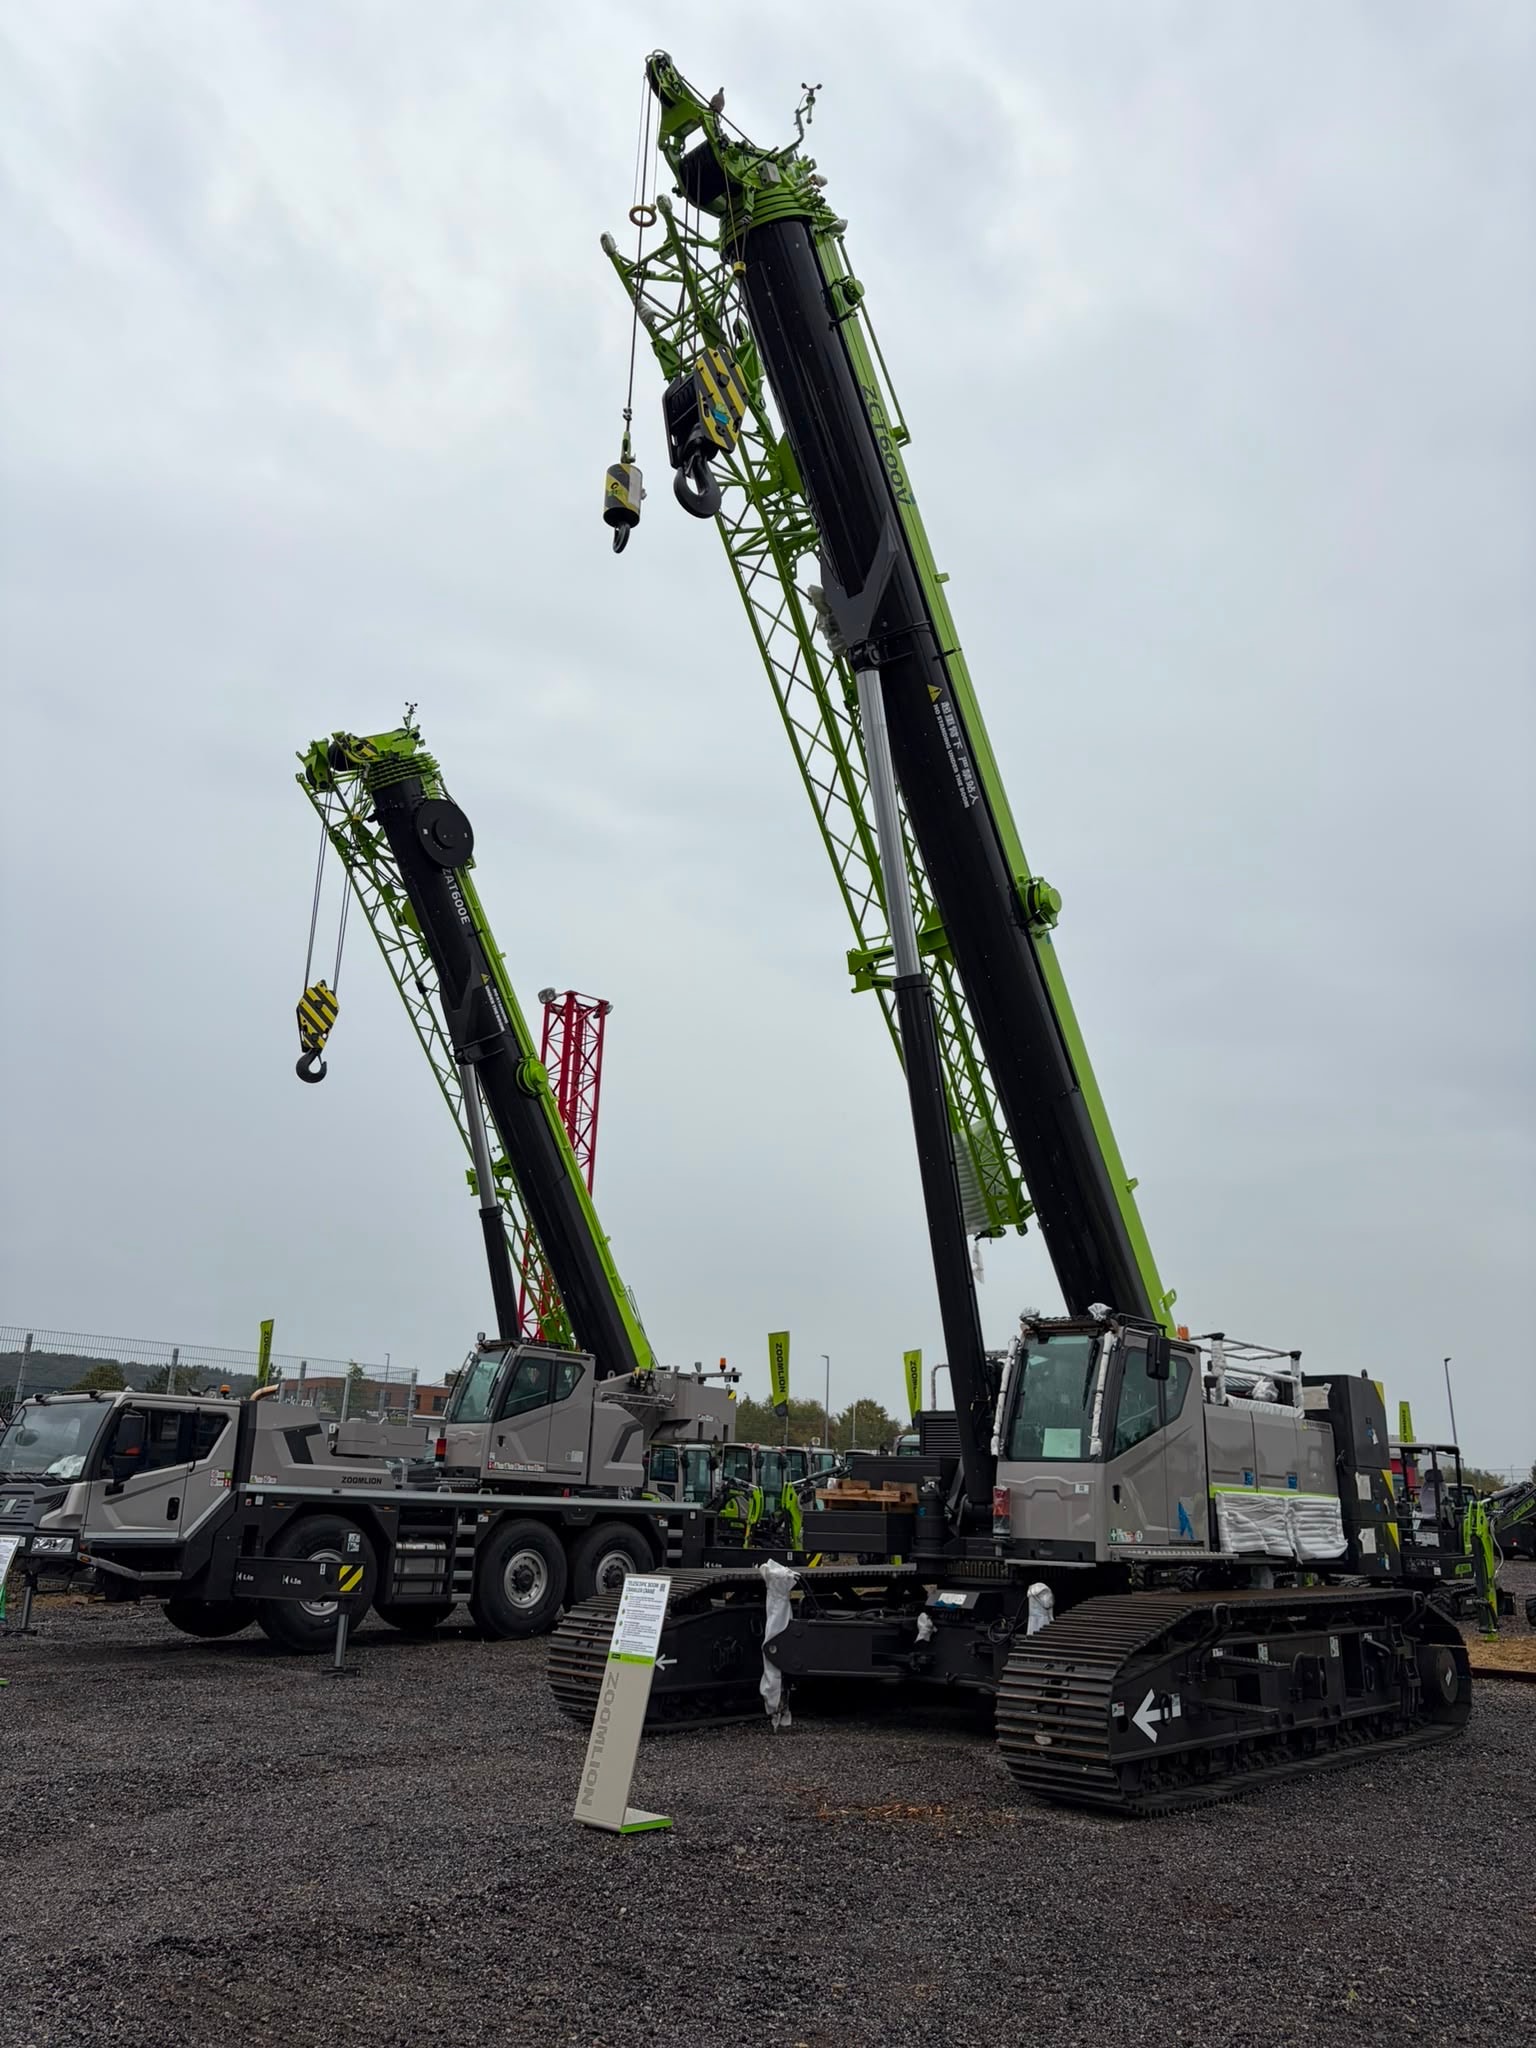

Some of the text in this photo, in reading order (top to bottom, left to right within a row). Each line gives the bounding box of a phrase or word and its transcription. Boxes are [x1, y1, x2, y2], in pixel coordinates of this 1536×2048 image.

[860, 384, 911, 506] ZCT600V
[937, 716, 951, 749] STANDING
[948, 750, 959, 775] UNDER
[959, 788, 970, 809] BOOM
[441, 867, 471, 925] ZAT600E
[775, 1342, 786, 1393] ZOOMLION
[341, 1476, 382, 1485] ZOOMLION
[581, 1671, 620, 1806] ZOOMLION
